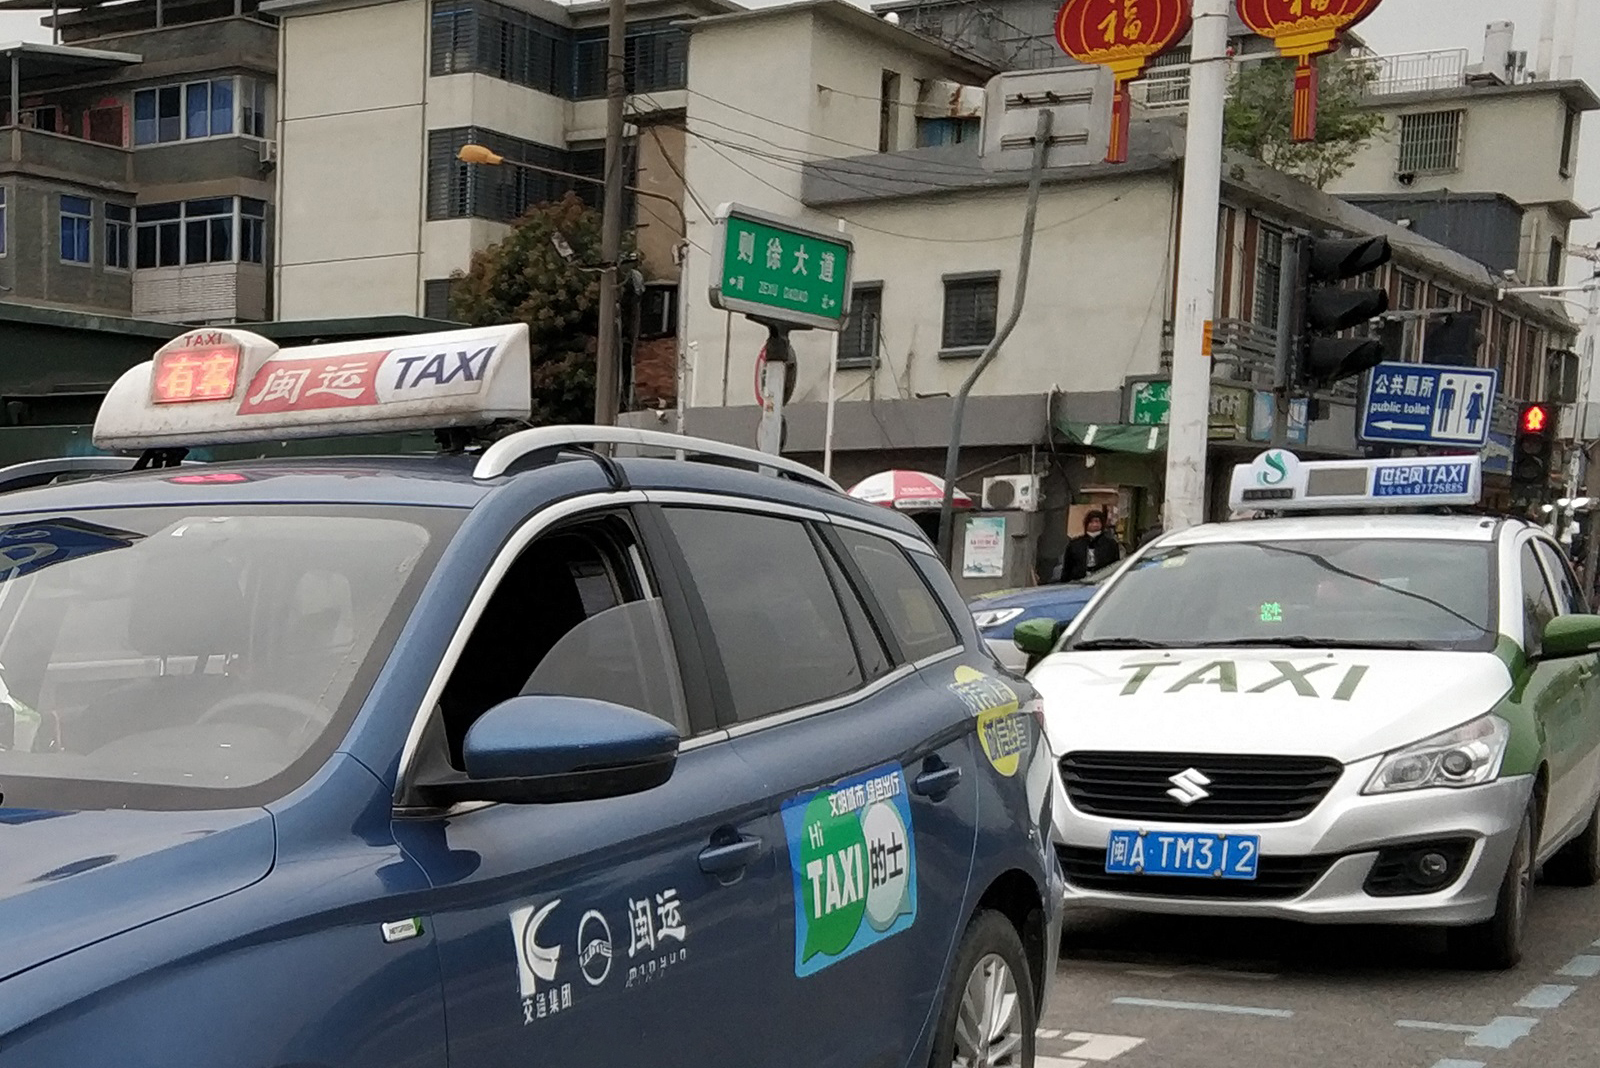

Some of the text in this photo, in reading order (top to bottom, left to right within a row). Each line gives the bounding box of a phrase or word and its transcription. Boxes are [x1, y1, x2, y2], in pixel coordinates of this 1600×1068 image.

[184, 333, 223, 347] TAXI
[249, 346, 498, 406] 闽运 TAXI
[1375, 374, 1435, 398] 公共厕所
[1370, 401, 1431, 416] public toilet
[1426, 465, 1467, 483] TAXI
[1119, 659, 1371, 702] TAXI
[808, 819, 825, 849] Hi
[869, 832, 904, 889] 的士
[806, 843, 864, 919] TAXI
[628, 888, 687, 958] 闽运
